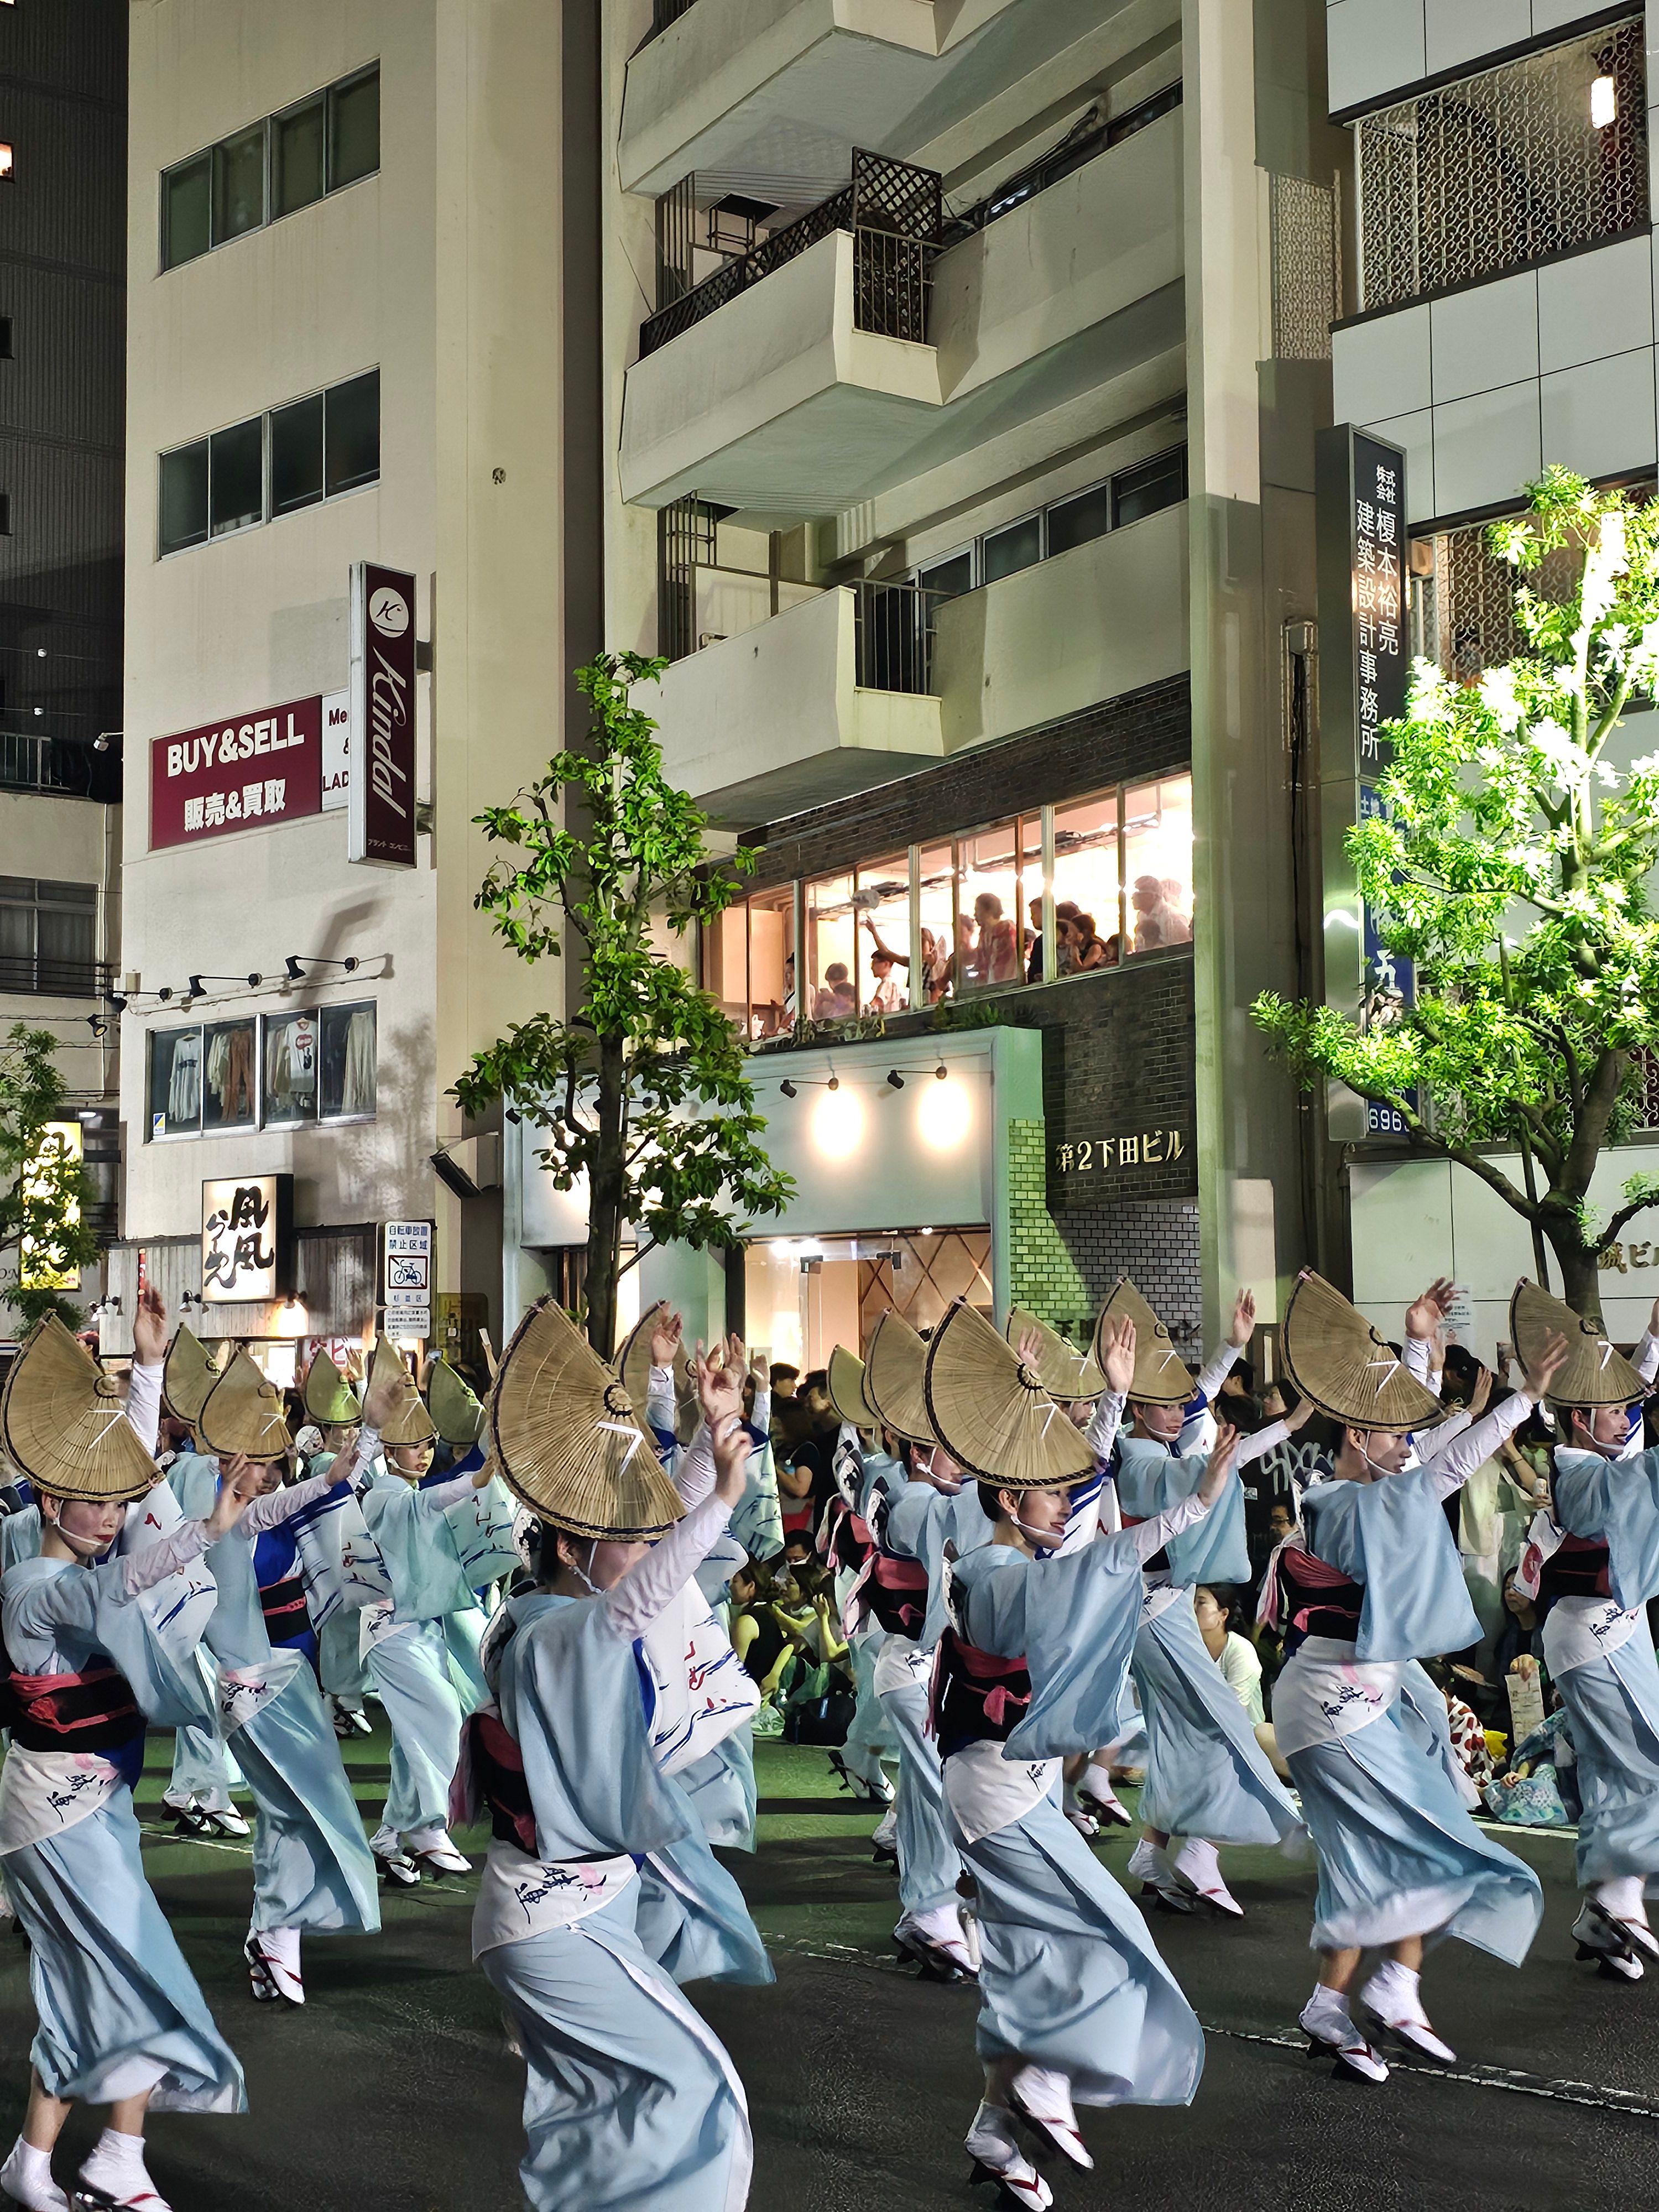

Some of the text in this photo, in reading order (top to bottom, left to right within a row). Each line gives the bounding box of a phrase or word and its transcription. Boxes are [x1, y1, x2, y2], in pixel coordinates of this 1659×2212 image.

[1356, 499, 1380, 761] 建築設計事務所
[168, 713, 305, 778] BUY&SELL
[372, 645, 406, 819] Kindal
[184, 779, 286, 832] 販売&買取
[1056, 1130, 1187, 1172] 第2下田ビル
